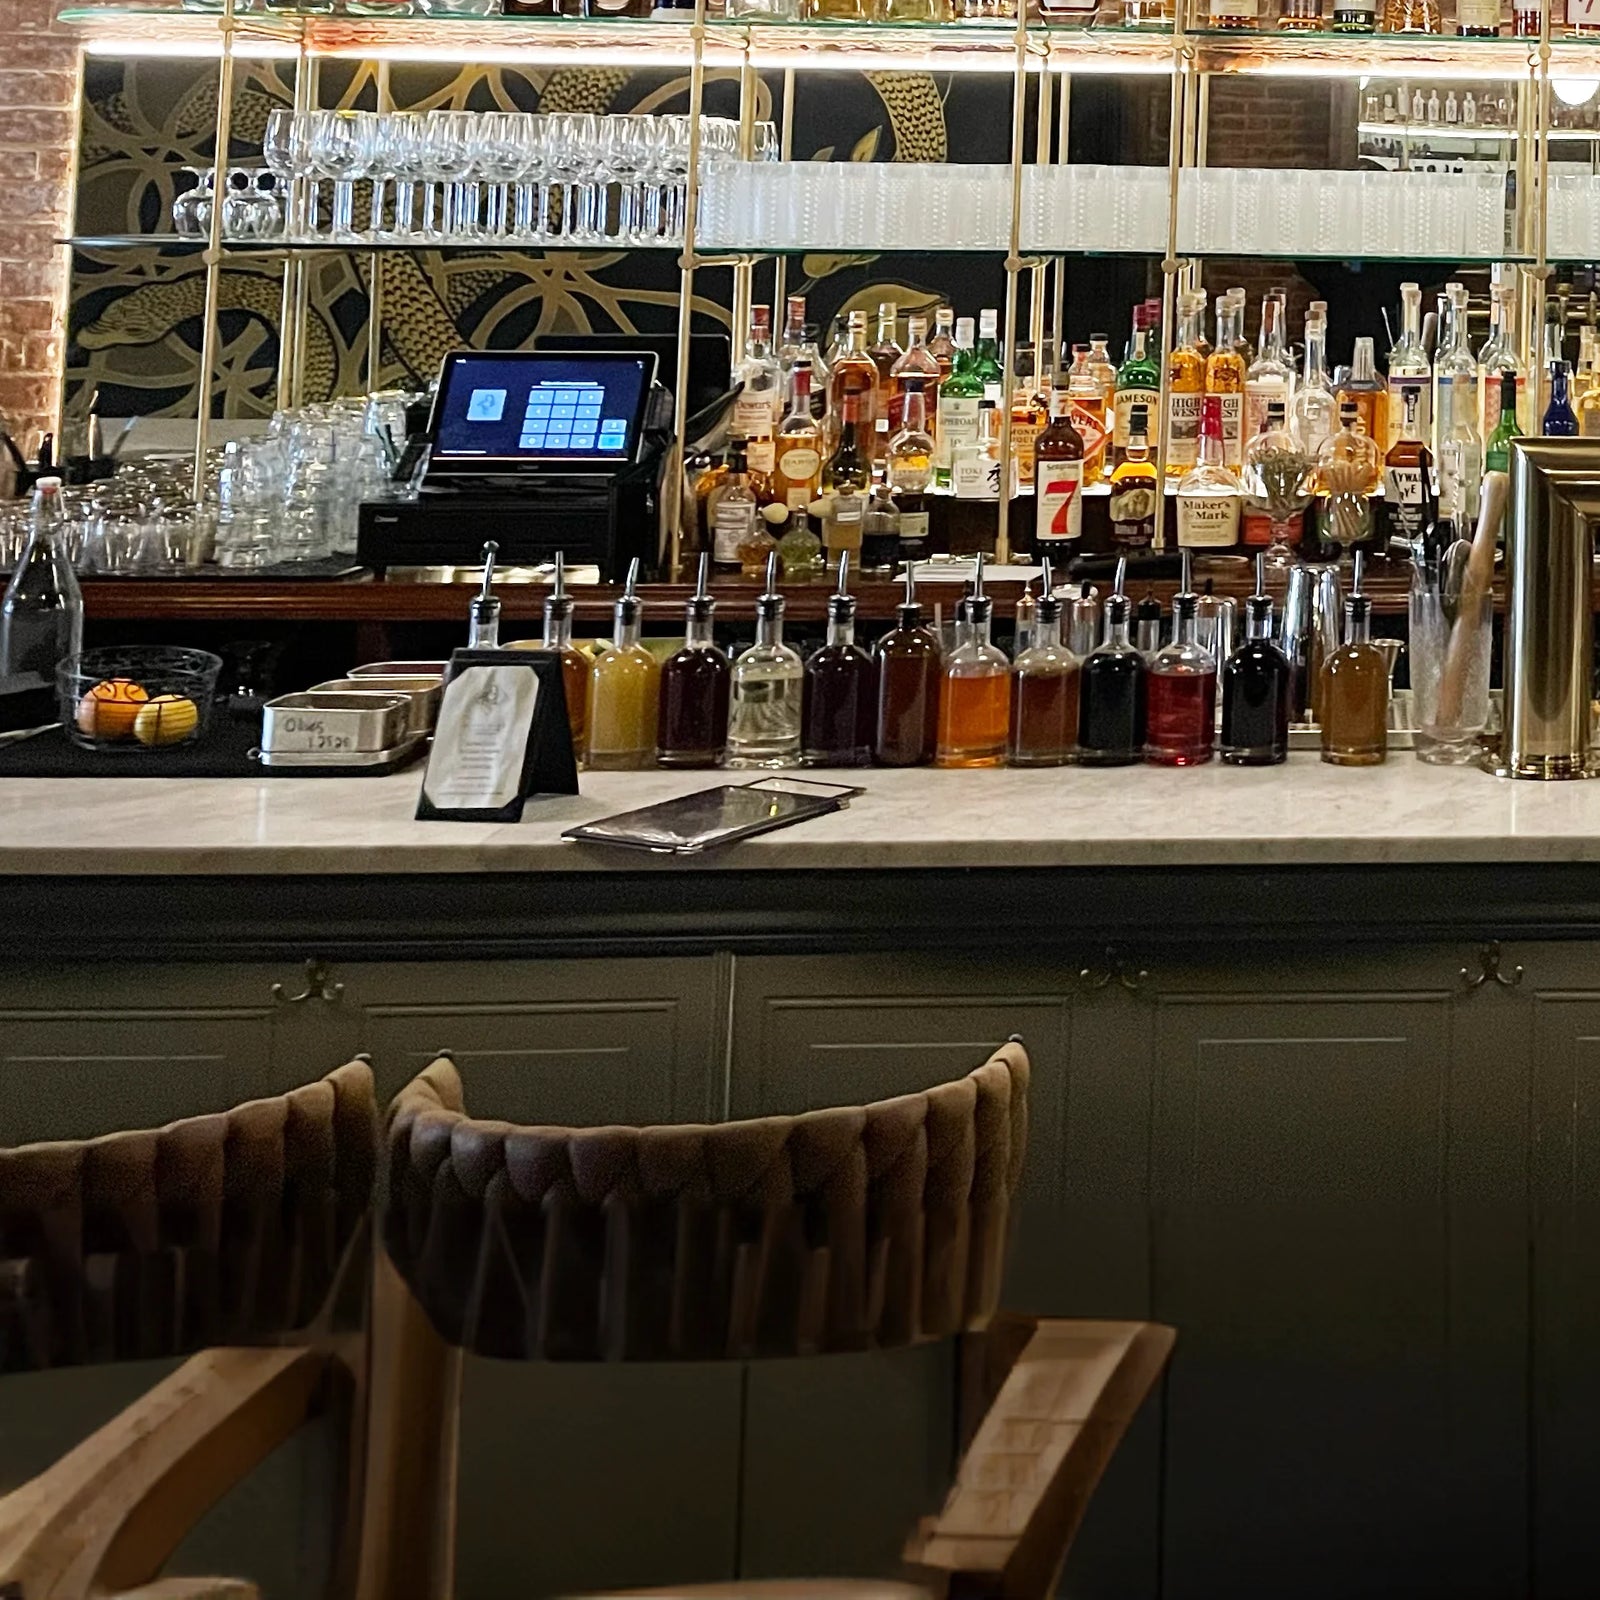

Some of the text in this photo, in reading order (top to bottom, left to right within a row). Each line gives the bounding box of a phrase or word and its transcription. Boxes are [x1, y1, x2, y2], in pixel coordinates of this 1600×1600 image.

[1116, 393, 1159, 406] JAMESON
[1171, 397, 1200, 408] HIGH
[1222, 398, 1239, 408] GH
[1171, 408, 1200, 418] WEST
[1045, 479, 1078, 535] 7
[1183, 499, 1231, 511] Maker's
